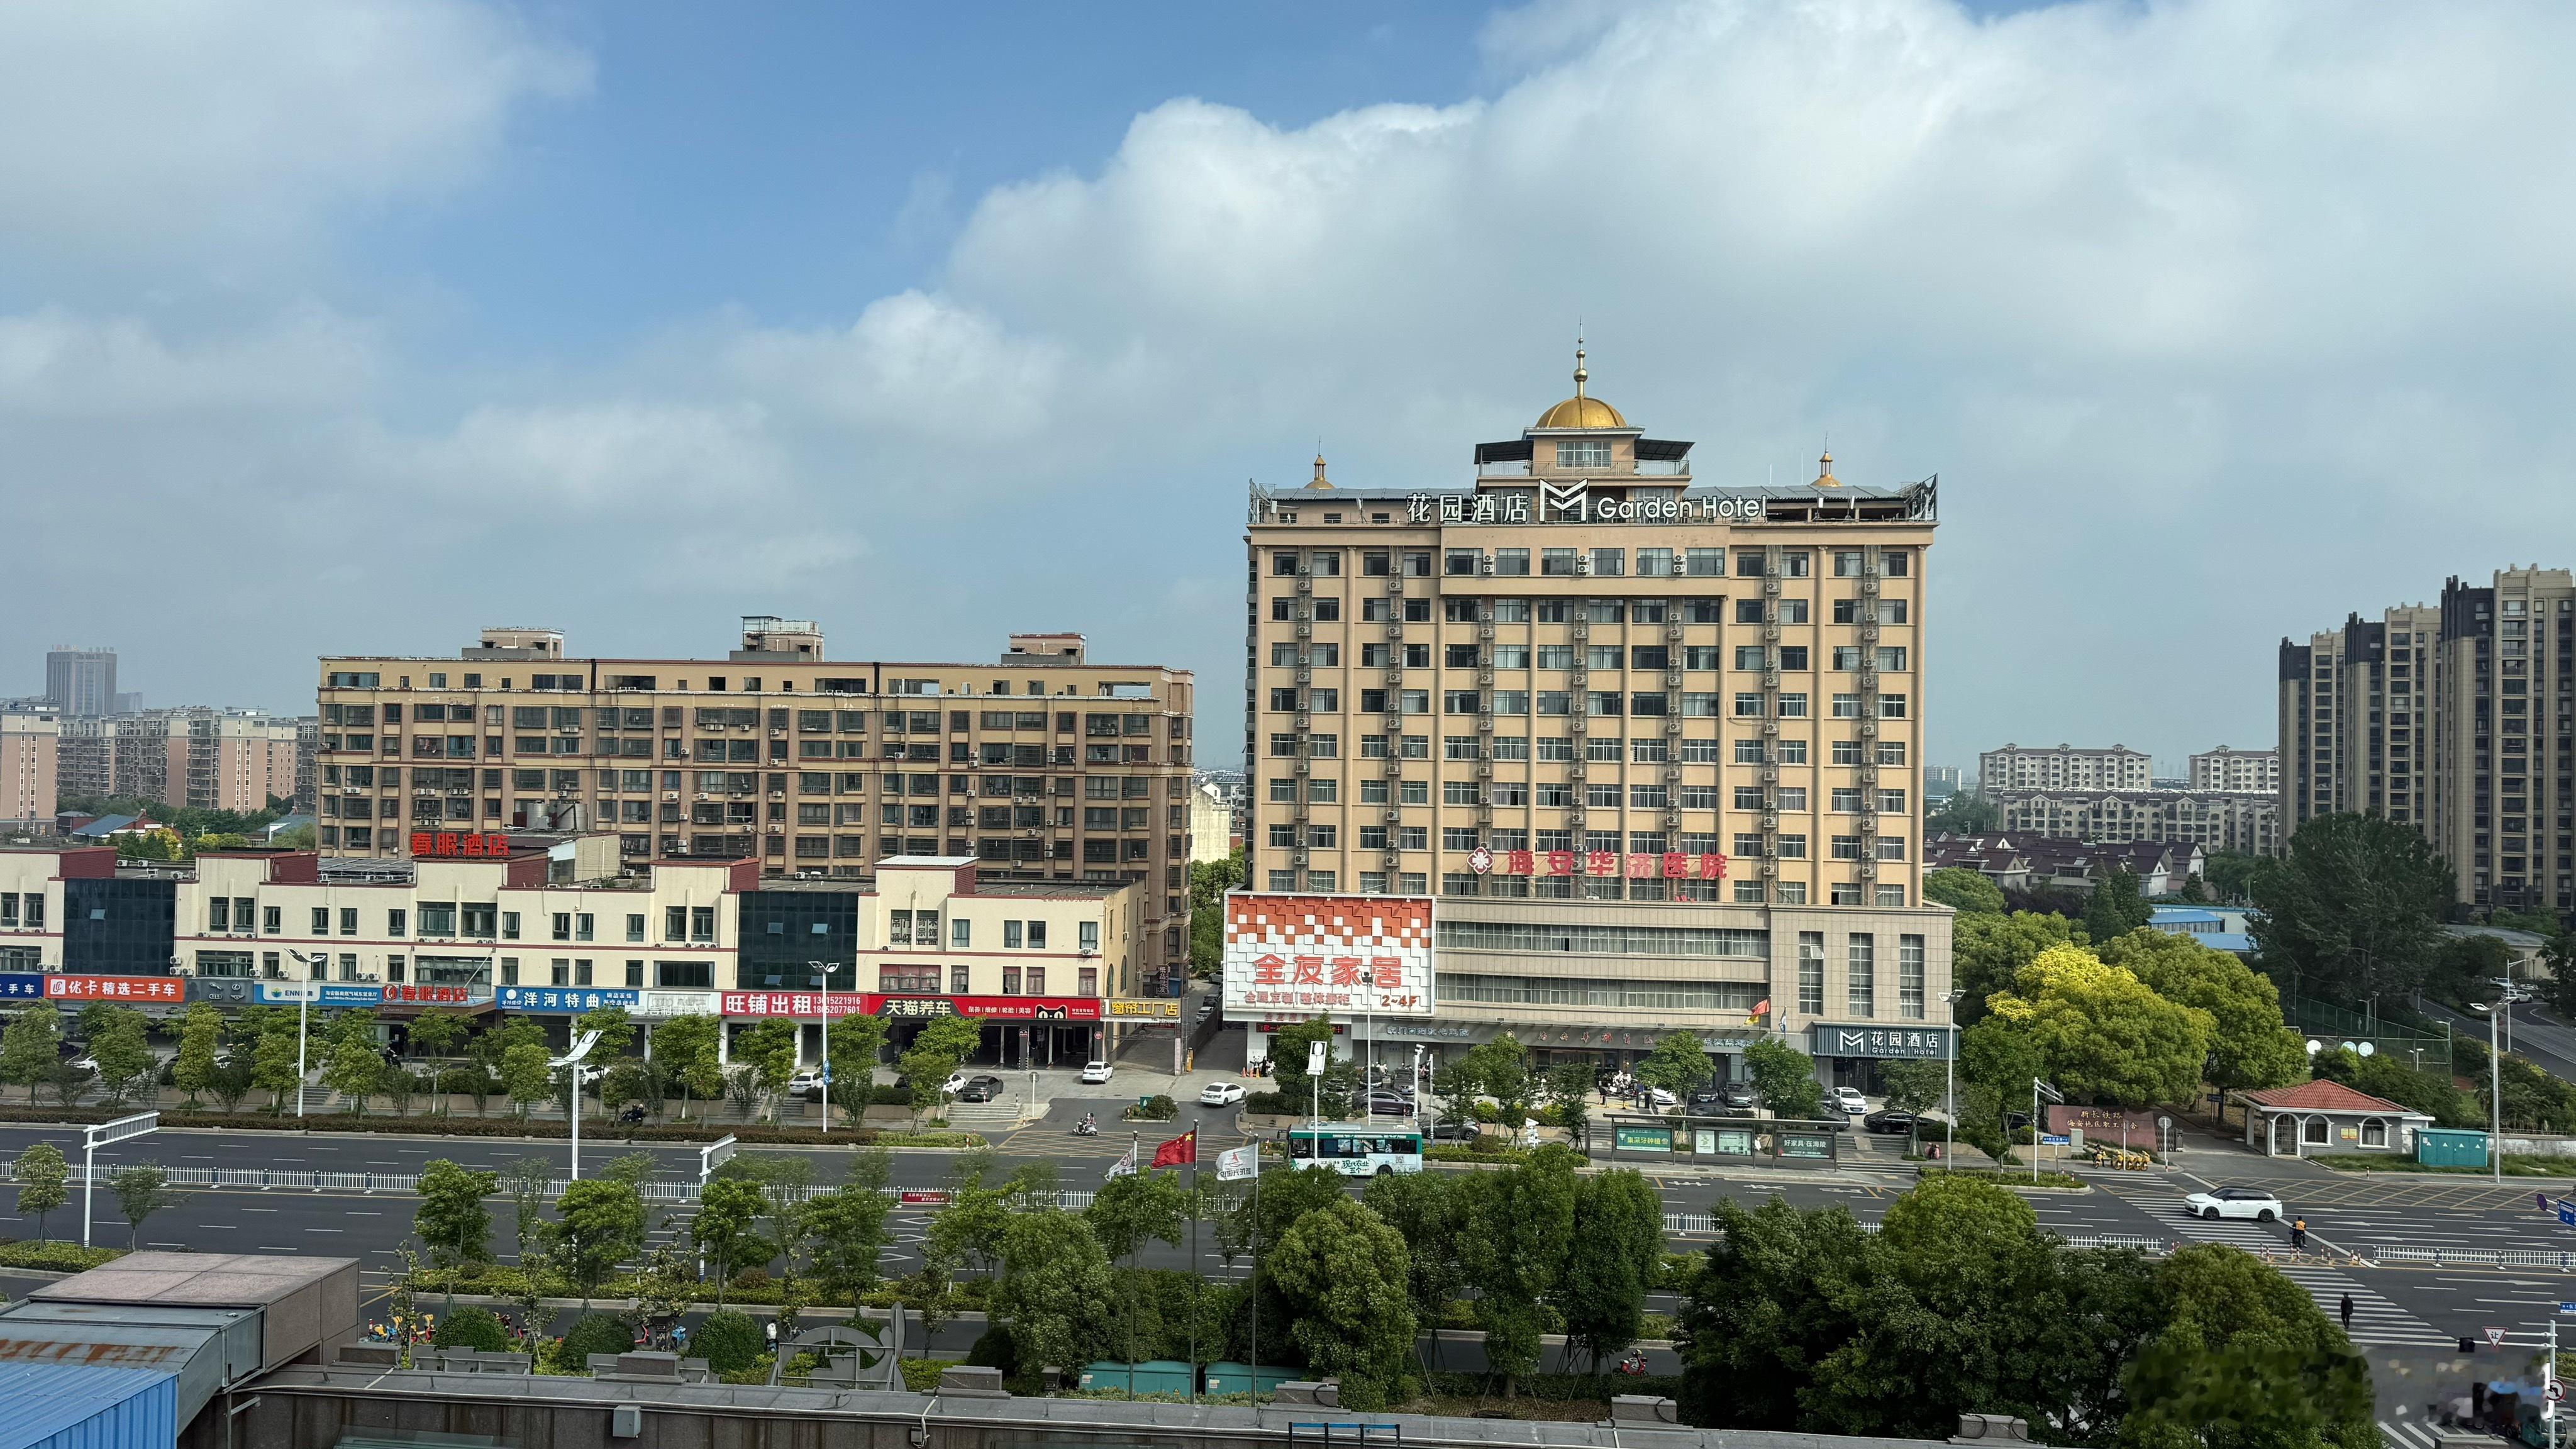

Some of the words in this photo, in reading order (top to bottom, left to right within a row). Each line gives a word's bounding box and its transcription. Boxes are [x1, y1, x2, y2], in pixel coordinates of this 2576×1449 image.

[1406, 492, 1529, 523] 花园酒店
[1597, 496, 1693, 519] Garden
[1702, 495, 1768, 519] Hotel
[1509, 849, 1728, 879] 海安华济医院
[1253, 953, 1402, 988] 全友家居
[0, 984, 35, 994] 手车
[69, 979, 176, 997] 优卡精选二手车
[524, 992, 599, 1008] 洋河特曲
[726, 994, 812, 1014] 旺铺出租
[813, 996, 861, 1005] 1315221916
[886, 999, 951, 1016] 天猫养车
[813, 1006, 860, 1014] 1852077601
[1111, 1001, 1178, 1016] 窗帘工厂店
[1871, 1031, 1938, 1048] 花园酒店
[2067, 1119, 2138, 1130] 海安地区职工舍
[1341, 1160, 1369, 1168] 现代农业
[2490, 1331, 2499, 1340] 让
